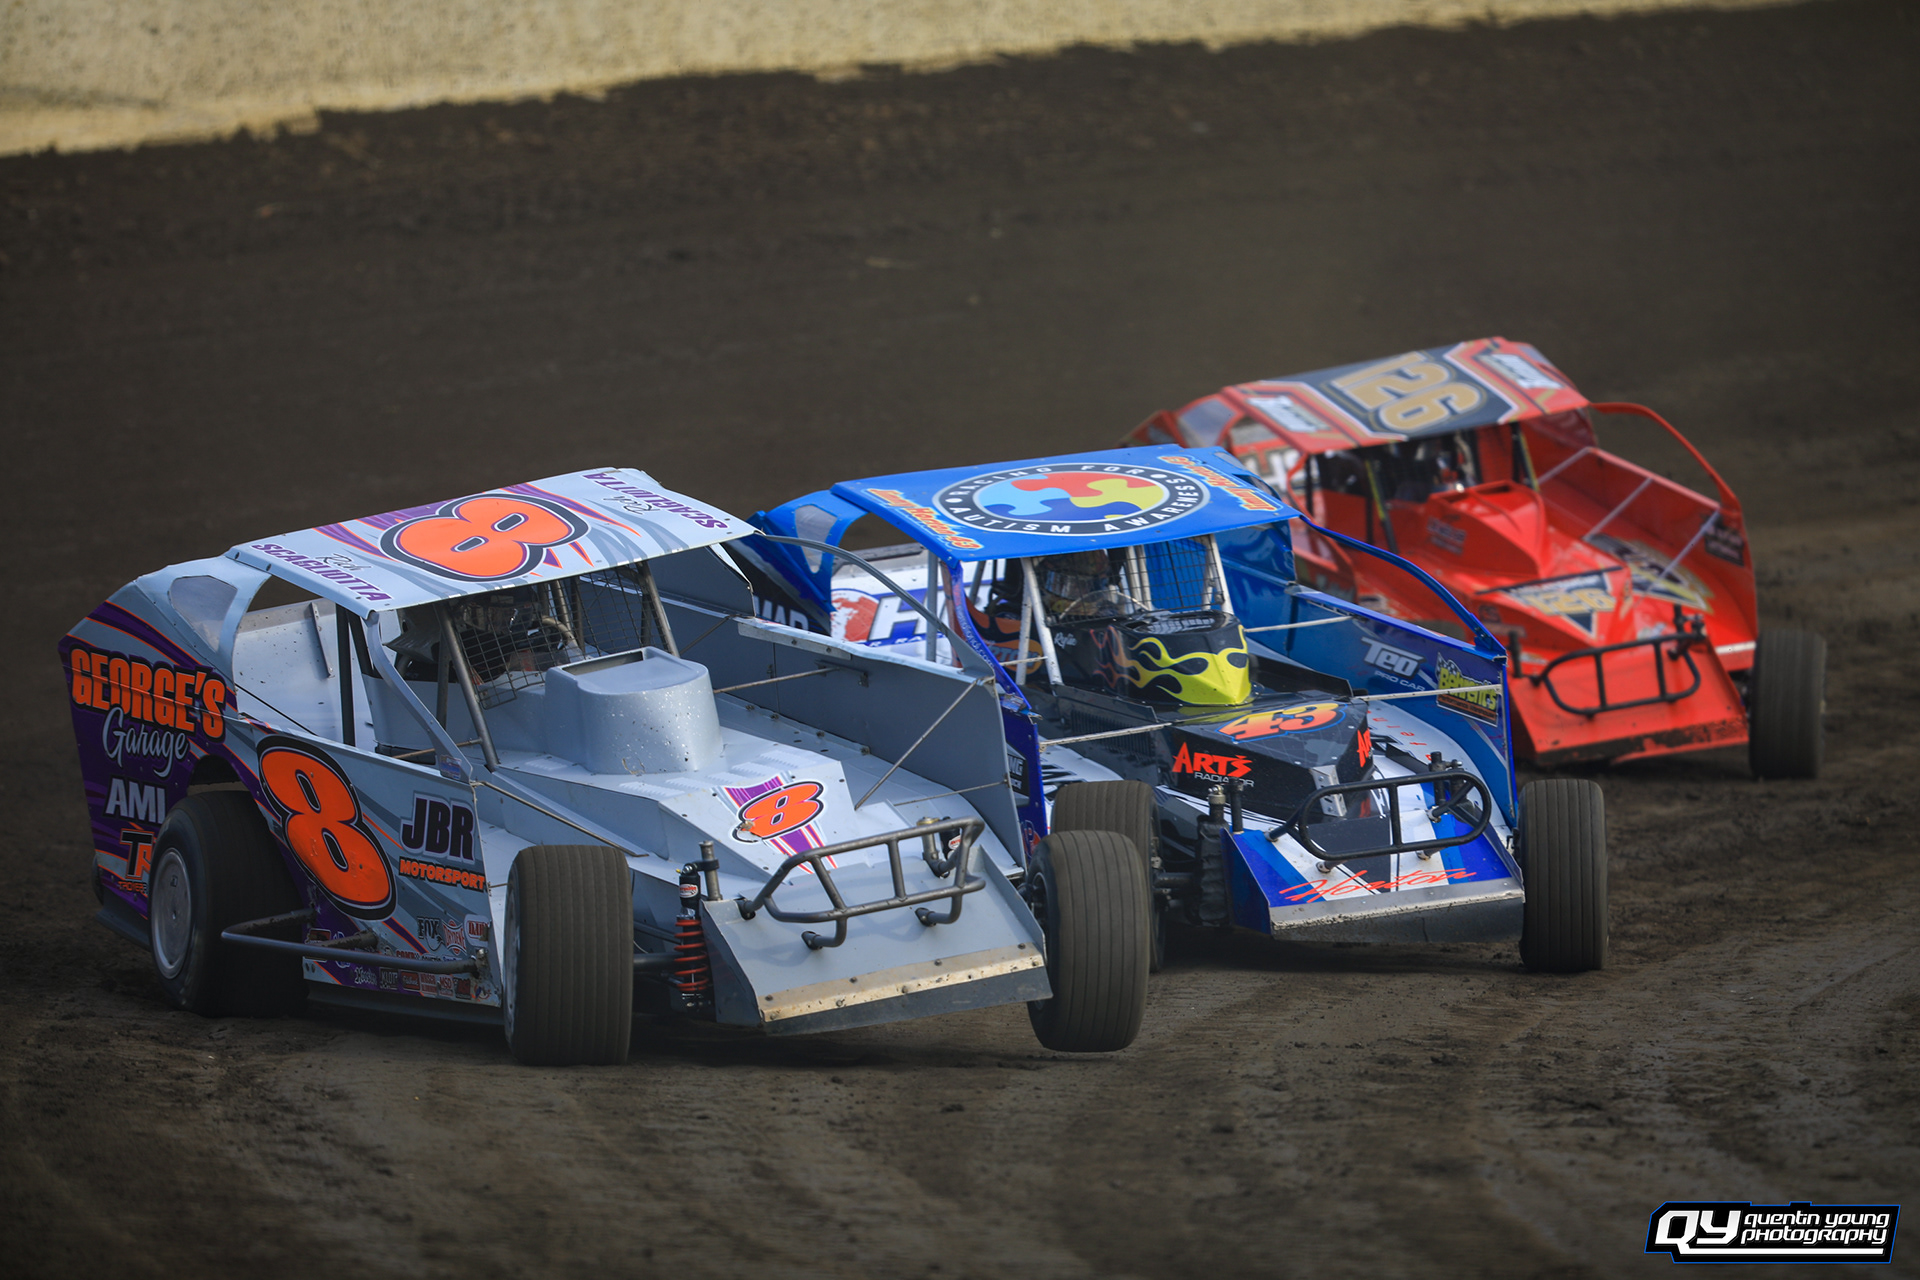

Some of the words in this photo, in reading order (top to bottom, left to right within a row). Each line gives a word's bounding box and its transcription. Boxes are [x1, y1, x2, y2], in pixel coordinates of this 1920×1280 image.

[949, 506, 1071, 533] AUTISM
[1104, 478, 1199, 531] AWARENESS
[954, 467, 1052, 496] RACING
[1081, 465, 1146, 475] FOR
[383, 494, 588, 582] 8
[252, 544, 391, 600] SCAGLIOTTA
[71, 649, 225, 738] GEORGE'S
[1374, 670, 1398, 683] PRO
[1399, 677, 1426, 691] CAR
[102, 707, 189, 778] Garage
[1219, 703, 1339, 740] 43
[258, 742, 393, 912] 8
[402, 798, 473, 861] JBR
[734, 782, 822, 840] 8
